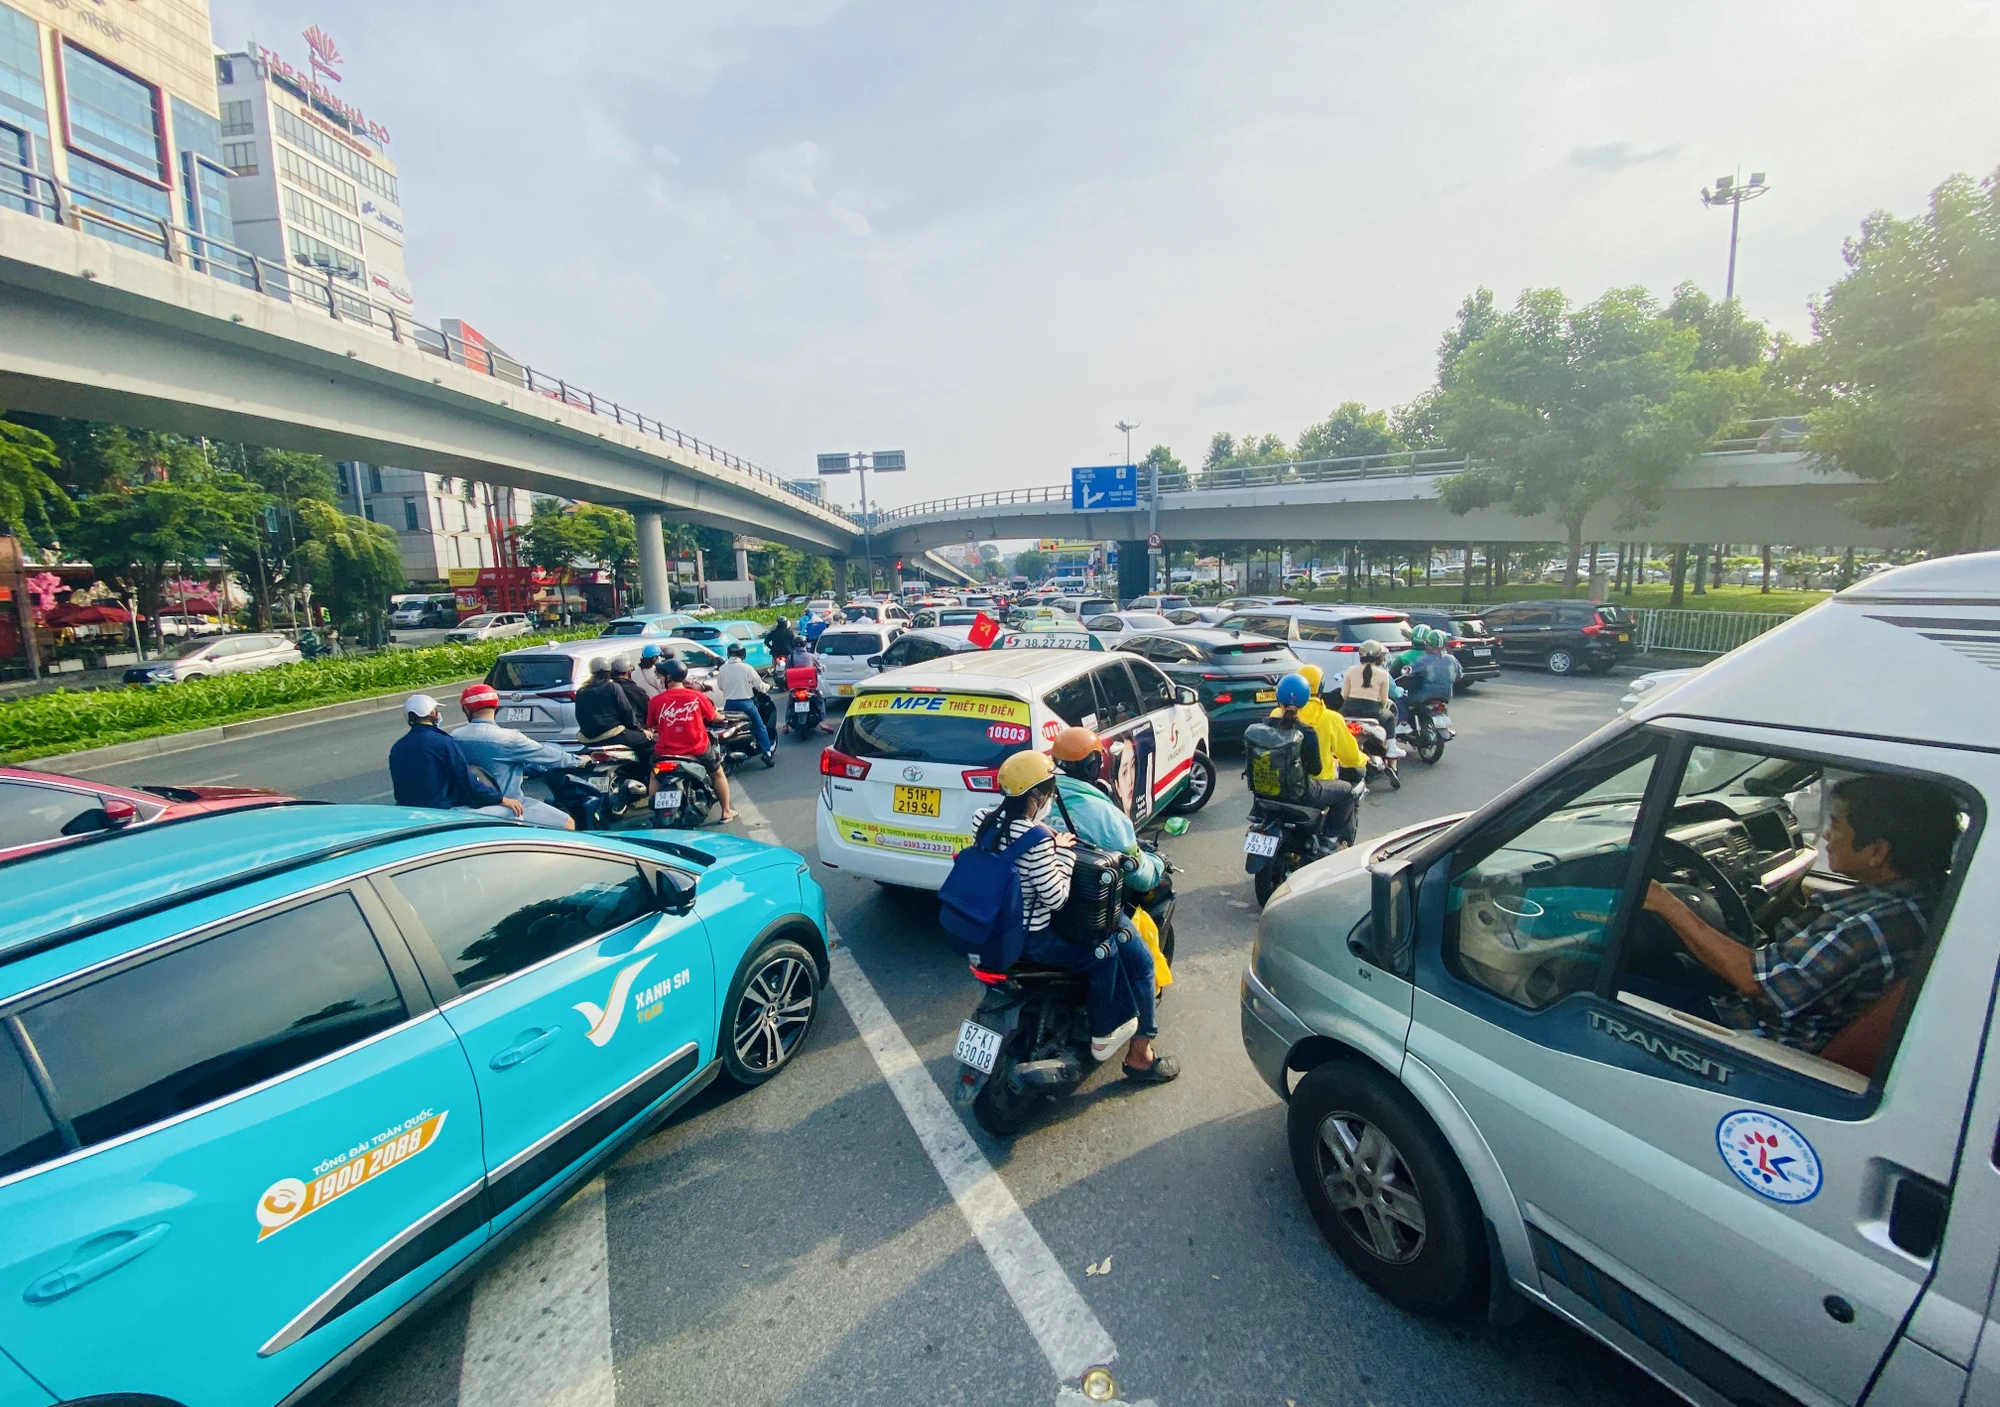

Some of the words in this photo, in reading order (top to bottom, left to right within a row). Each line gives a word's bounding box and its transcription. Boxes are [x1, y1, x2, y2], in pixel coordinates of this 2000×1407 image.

[1058, 638, 1071, 648] 27
[1074, 639, 1088, 649] 27
[873, 699, 889, 708] LED
[890, 696, 947, 711] MPE
[949, 698, 976, 712] THIẾT
[978, 705, 989, 716] BỊ
[990, 704, 1015, 717] ĐIỆN
[988, 725, 1026, 741] 10803
[906, 788, 928, 801] 51H
[898, 800, 934, 815] 219.94
[932, 843, 941, 851] 27
[635, 978, 672, 1011] XANH
[673, 968, 691, 990] SM
[636, 1001, 664, 1024] TAXI
[965, 1025, 995, 1051] 67-K1
[1587, 1011, 1735, 1084] TRANSIT
[957, 1041, 992, 1069] 930.08
[312, 1153, 347, 1176] TỔNG
[349, 1141, 370, 1158] ĐÀI
[371, 1124, 402, 1145] TOÀN
[403, 1107, 434, 1129] QUỐC
[312, 1157, 365, 1207] 1900
[369, 1127, 423, 1176] 2088
